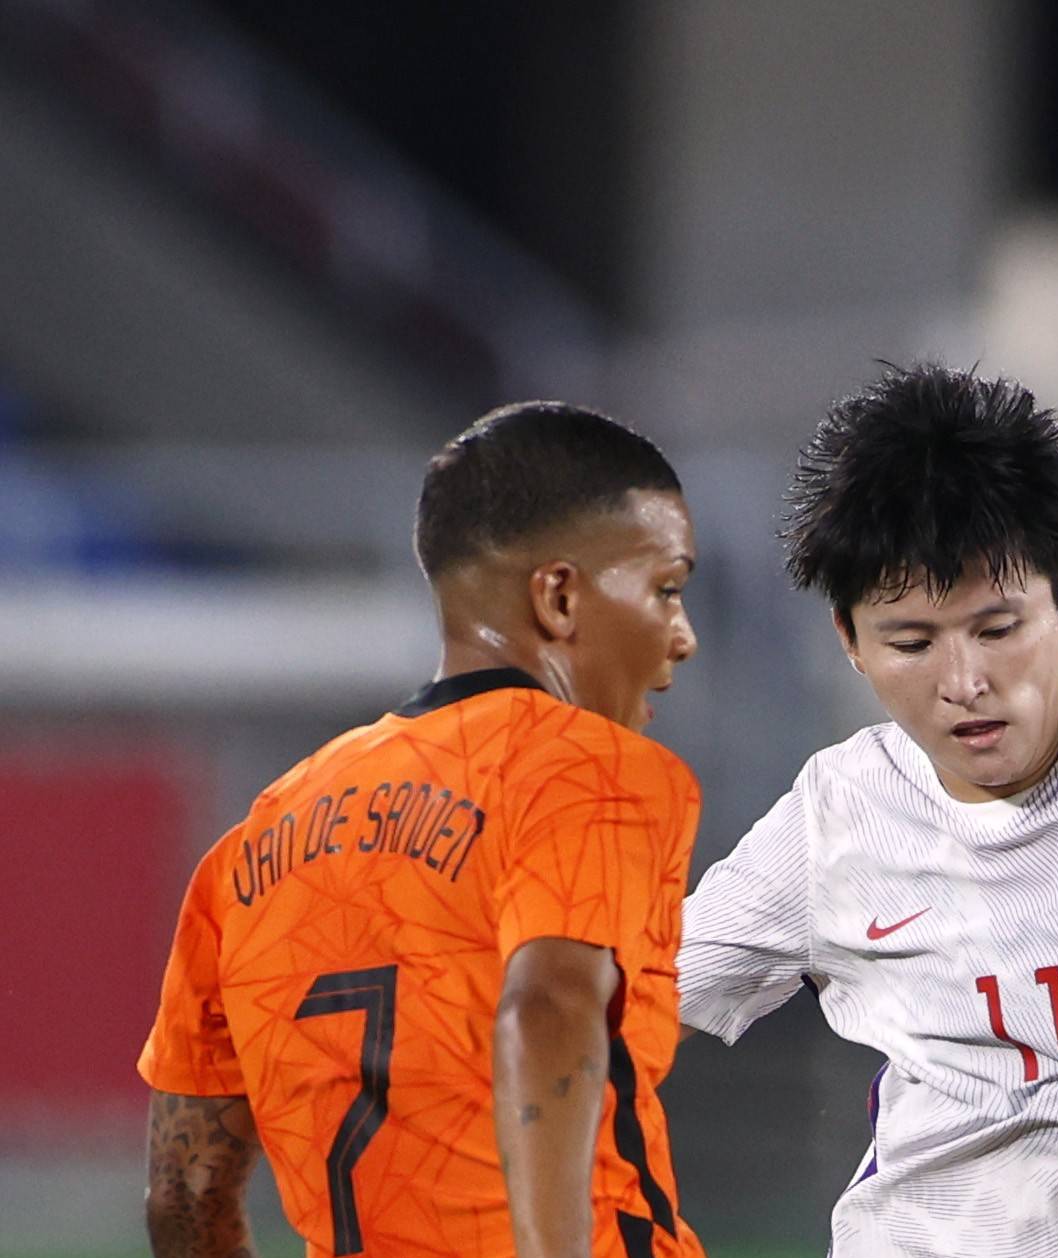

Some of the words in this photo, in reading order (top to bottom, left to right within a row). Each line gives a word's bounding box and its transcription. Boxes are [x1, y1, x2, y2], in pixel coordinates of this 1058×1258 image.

[233, 812, 295, 907] VAN
[304, 785, 358, 865] DE
[358, 781, 486, 883] SANDEN
[294, 964, 399, 1258] 7
